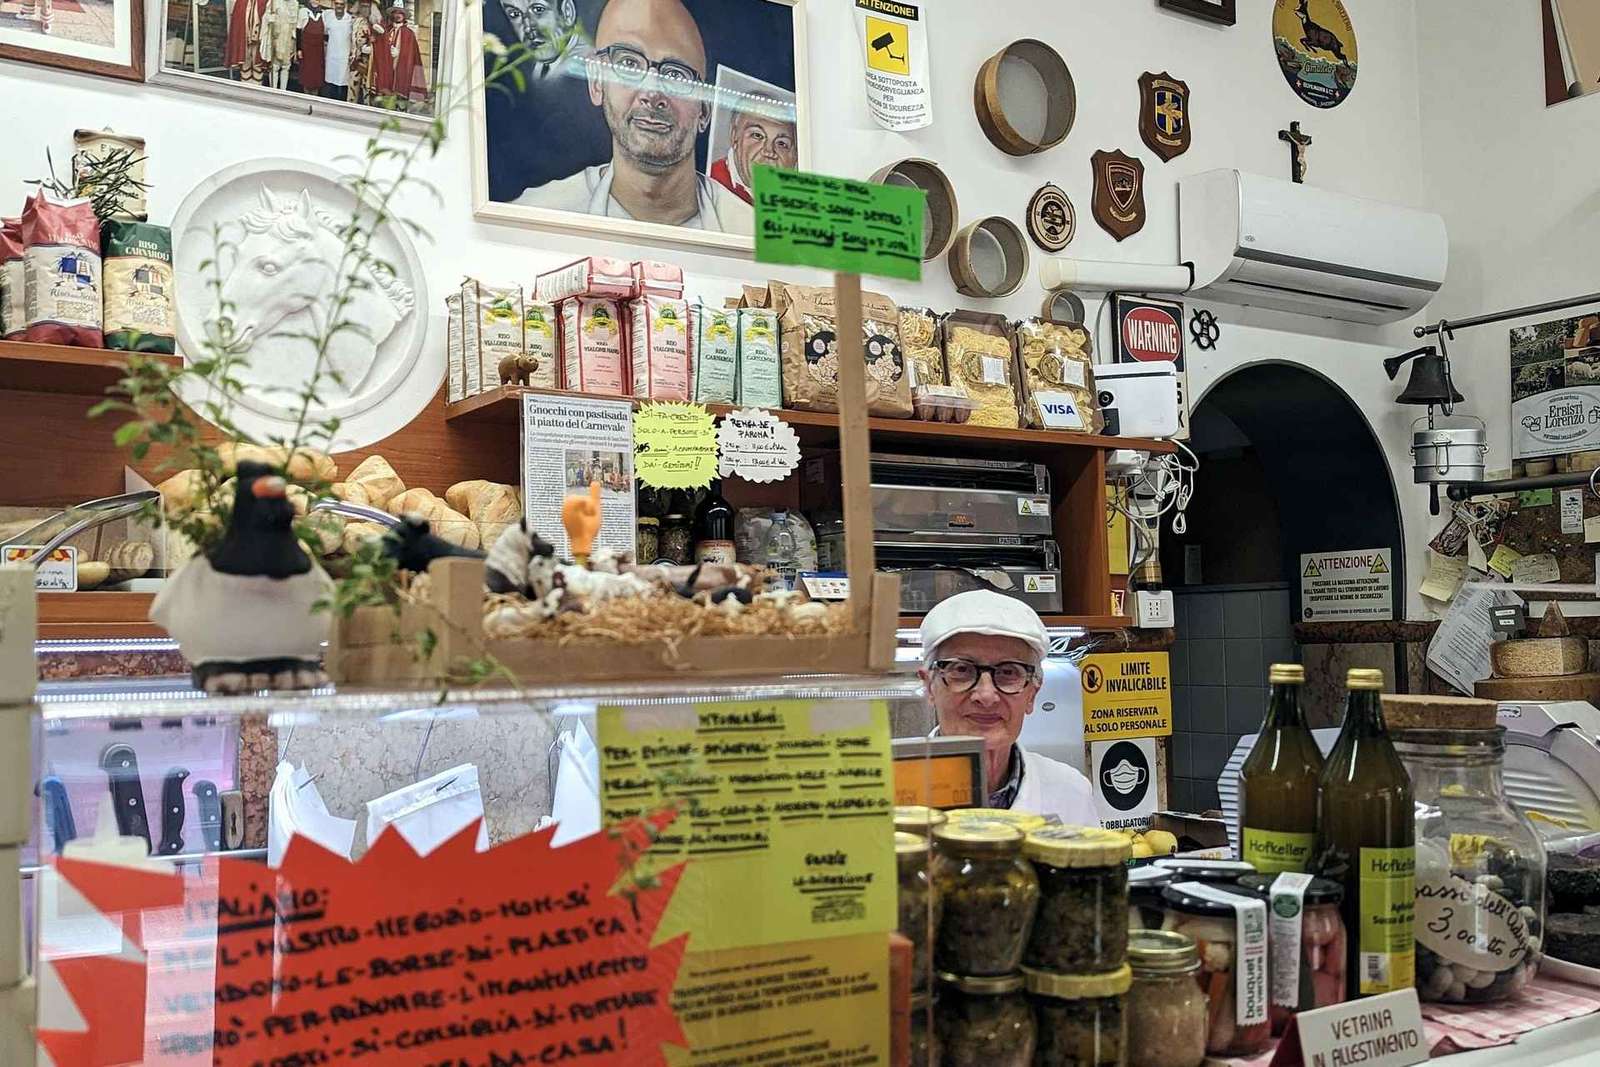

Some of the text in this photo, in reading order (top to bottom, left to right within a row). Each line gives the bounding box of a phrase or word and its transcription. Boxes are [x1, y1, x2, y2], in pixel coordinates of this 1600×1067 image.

[1127, 318, 1177, 354] WARNING
[529, 404, 628, 421] Gnocchi con pastisada
[1043, 403, 1075, 416] VISA
[529, 416, 626, 432] il piatto del Carnevale
[1545, 415, 1585, 429] Lorenzo
[1318, 555, 1373, 570] ATTENZIONE
[1121, 662, 1151, 676] LIMITE
[1106, 677, 1167, 693] INVALICABILE
[1091, 706, 1158, 719] ZONA RISERVATA
[1084, 719, 1167, 734] AL SOLO PERSONALE
[1250, 838, 1307, 857] Hofkeller
[1246, 958, 1256, 1019] bouquet
[1331, 1009, 1393, 1040] VETRINA
[1312, 1029, 1418, 1067] IN ALLESTIMENTO
